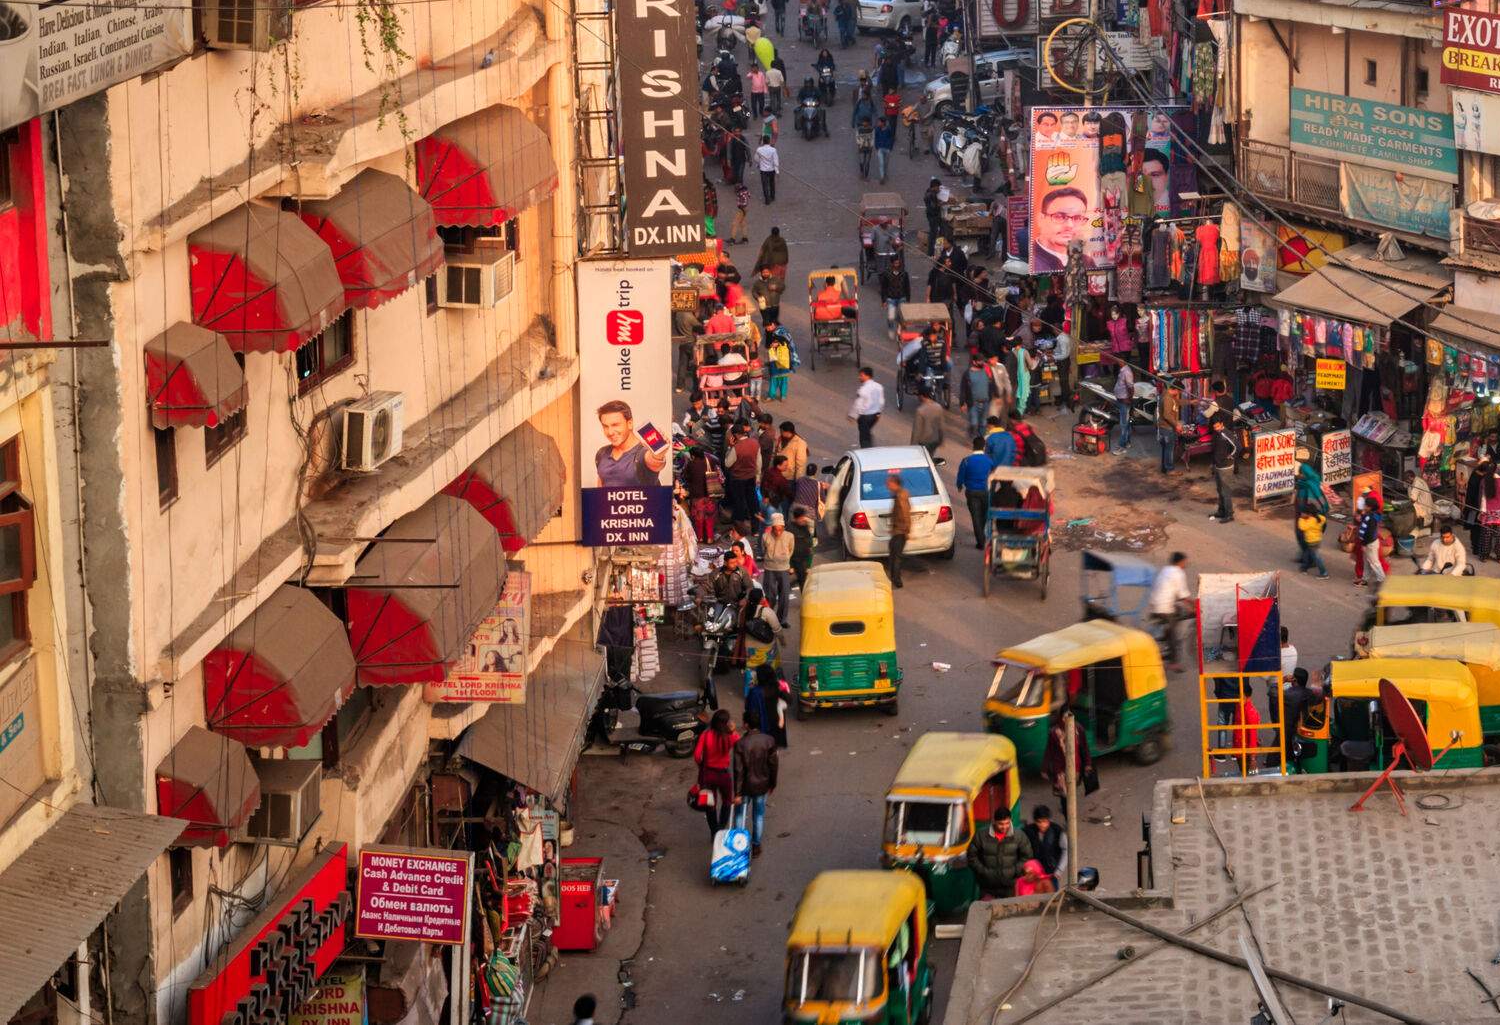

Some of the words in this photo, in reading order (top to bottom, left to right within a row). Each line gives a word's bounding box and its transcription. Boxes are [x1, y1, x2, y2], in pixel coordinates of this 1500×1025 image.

[39, 16, 56, 38] Have
[57, 6, 84, 31] Delicious
[39, 38, 69, 60] Indian,
[100, 32, 140, 57] Continental
[141, 24, 164, 42] Cuisine
[90, 60, 115, 84] LUNCH
[126, 45, 153, 70] DINNER
[1305, 94, 1364, 117] HIRA
[1373, 106, 1443, 132] SONS
[1303, 124, 1339, 138] READY
[1343, 131, 1374, 145] MADE
[1378, 138, 1443, 158] GARMENTS
[1408, 156, 1434, 167] SHOP
[616, 279, 634, 307] trip
[616, 312, 641, 342] my
[617, 348, 631, 391] make
[1256, 437, 1275, 454] HIRA
[1277, 433, 1296, 450] SONS
[1257, 455, 1275, 471] हीरा
[1256, 469, 1295, 483] READYMADE
[1256, 478, 1295, 494] GARMENTS
[607, 491, 647, 502] HOTEL
[611, 505, 644, 515] LORD
[600, 518, 654, 529] KRISHNA
[606, 532, 626, 543] DX.
[628, 532, 649, 543] INN
[371, 856, 405, 868] MONEY
[407, 859, 457, 873] EXCHANGE
[363, 867, 388, 879] Cash
[390, 870, 431, 883] Advance
[434, 873, 464, 885] Credit
[393, 882, 418, 894] Debit
[420, 886, 444, 896] Card
[370, 896, 407, 910] Обмен
[410, 903, 453, 914] валюты
[292, 1002, 360, 1017] KRISHNA
